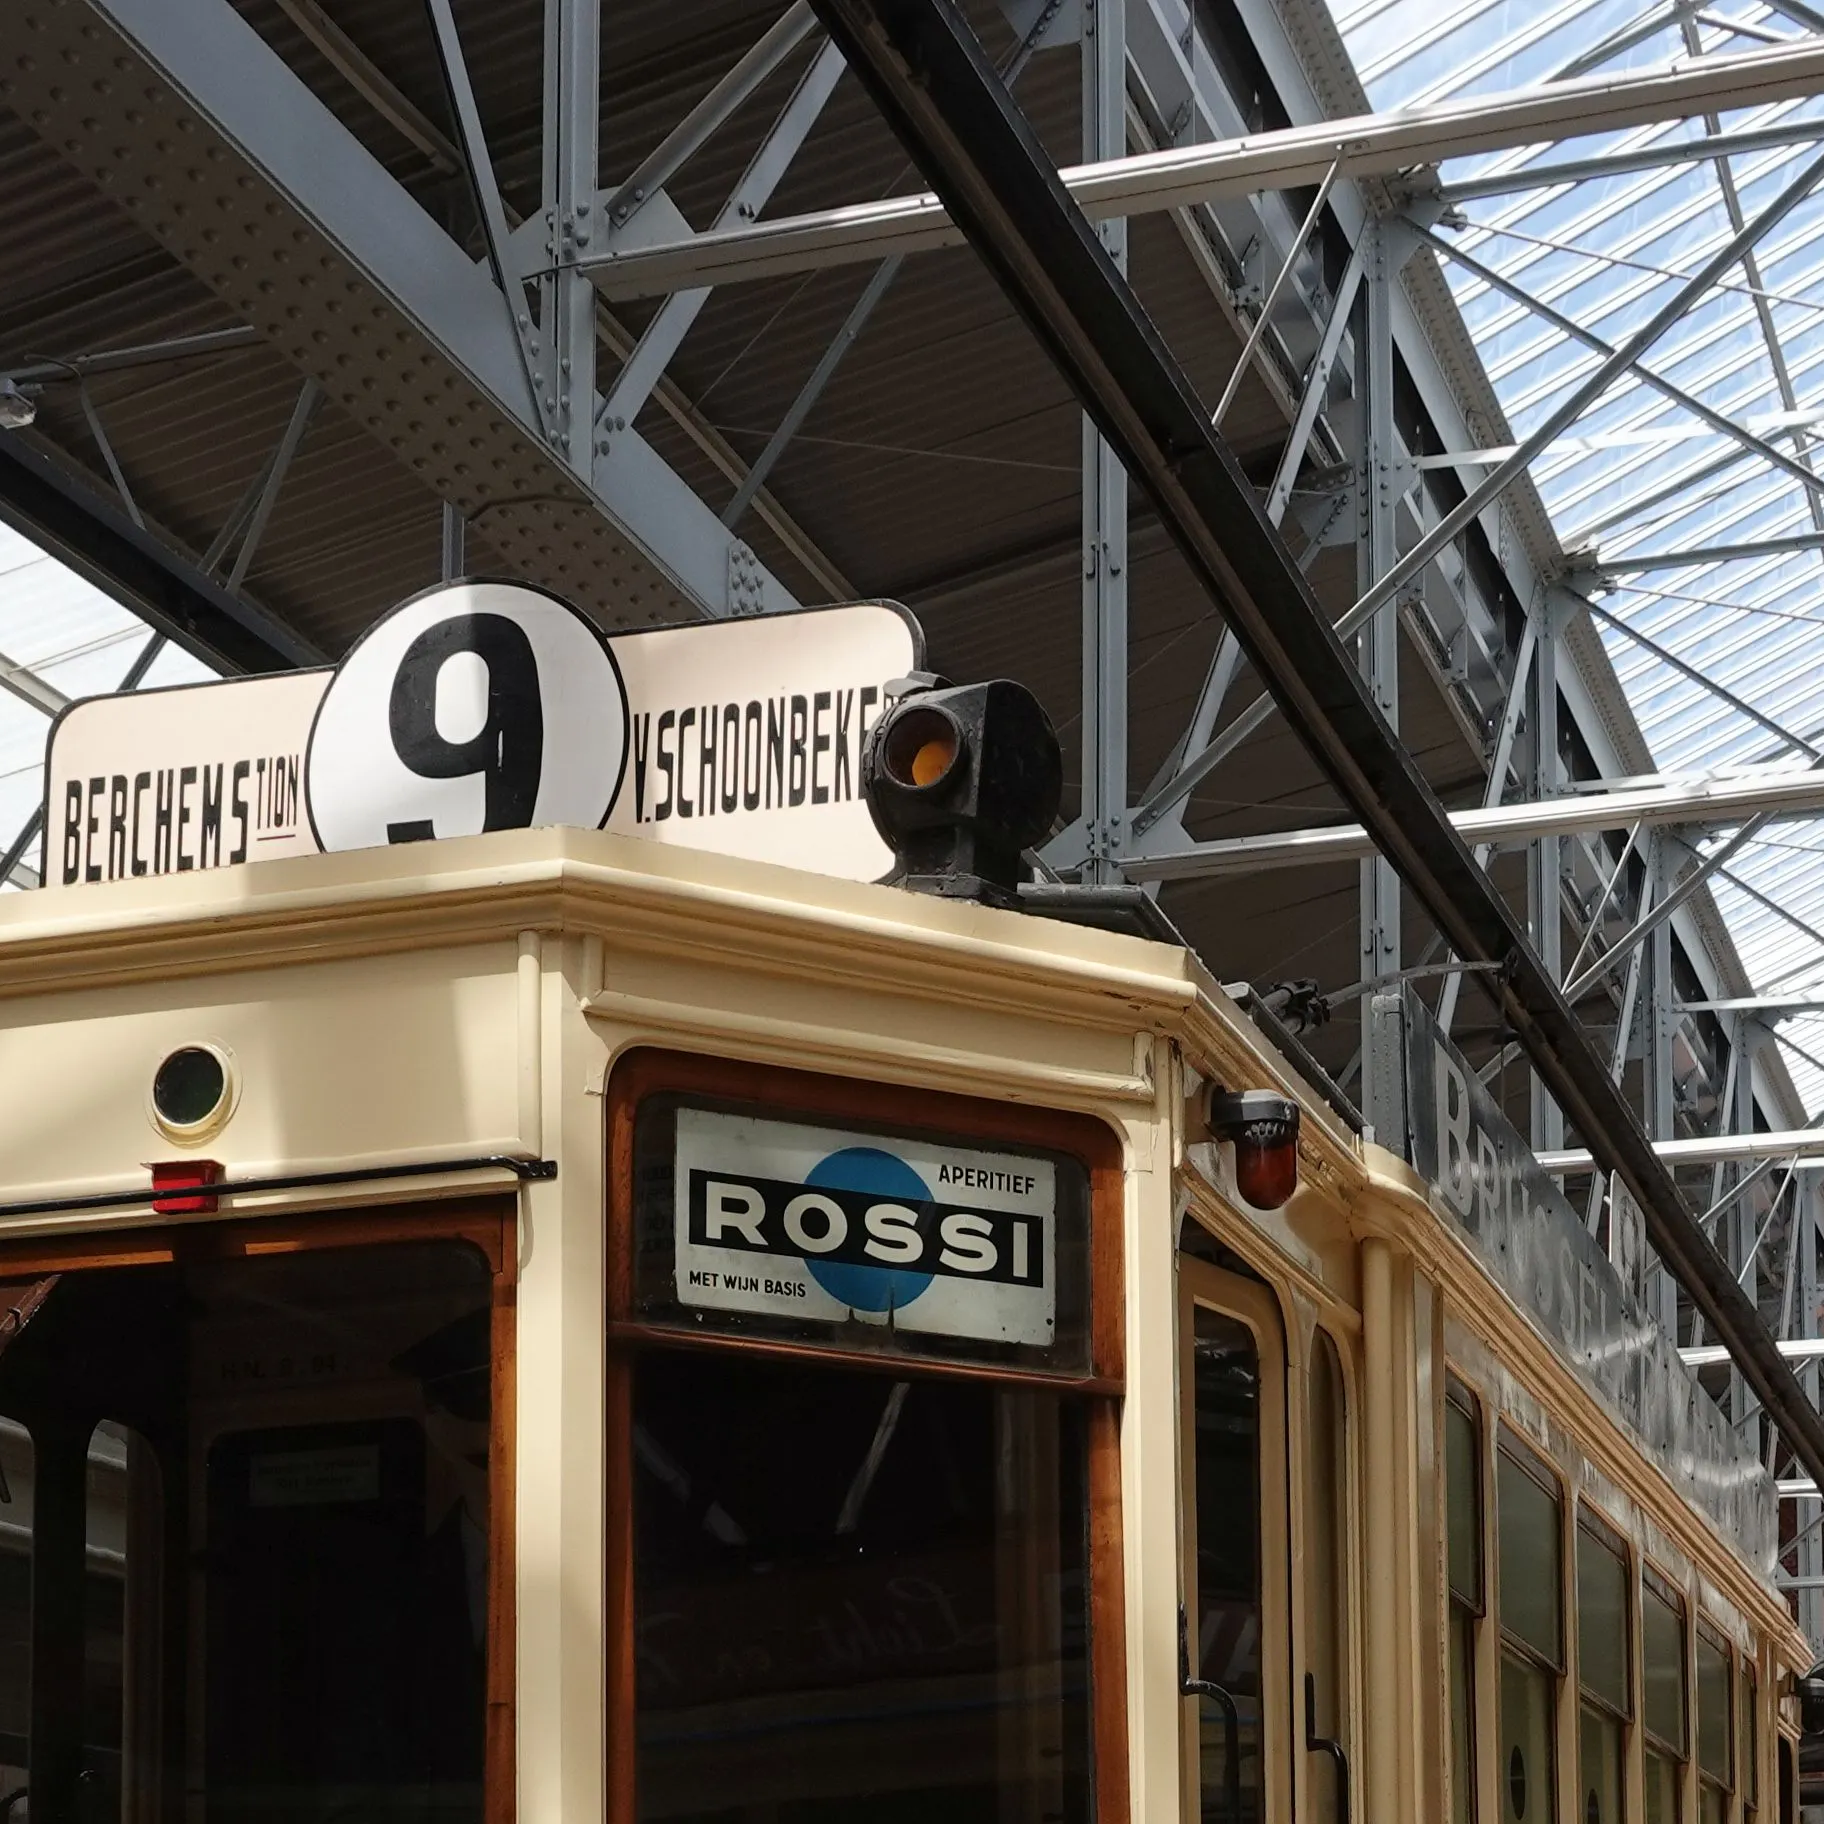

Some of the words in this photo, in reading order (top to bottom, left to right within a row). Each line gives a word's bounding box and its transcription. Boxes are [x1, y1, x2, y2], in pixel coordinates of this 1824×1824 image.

[388, 612, 543, 843] 9
[634, 685, 898, 824] V.SCHOONBEKE
[938, 1164, 1034, 1195] APERITIEF
[705, 1181, 1029, 1279] ROSSI
[689, 1271, 718, 1288] MET
[724, 1274, 760, 1293] WIJN
[764, 1279, 806, 1298] BASIS
